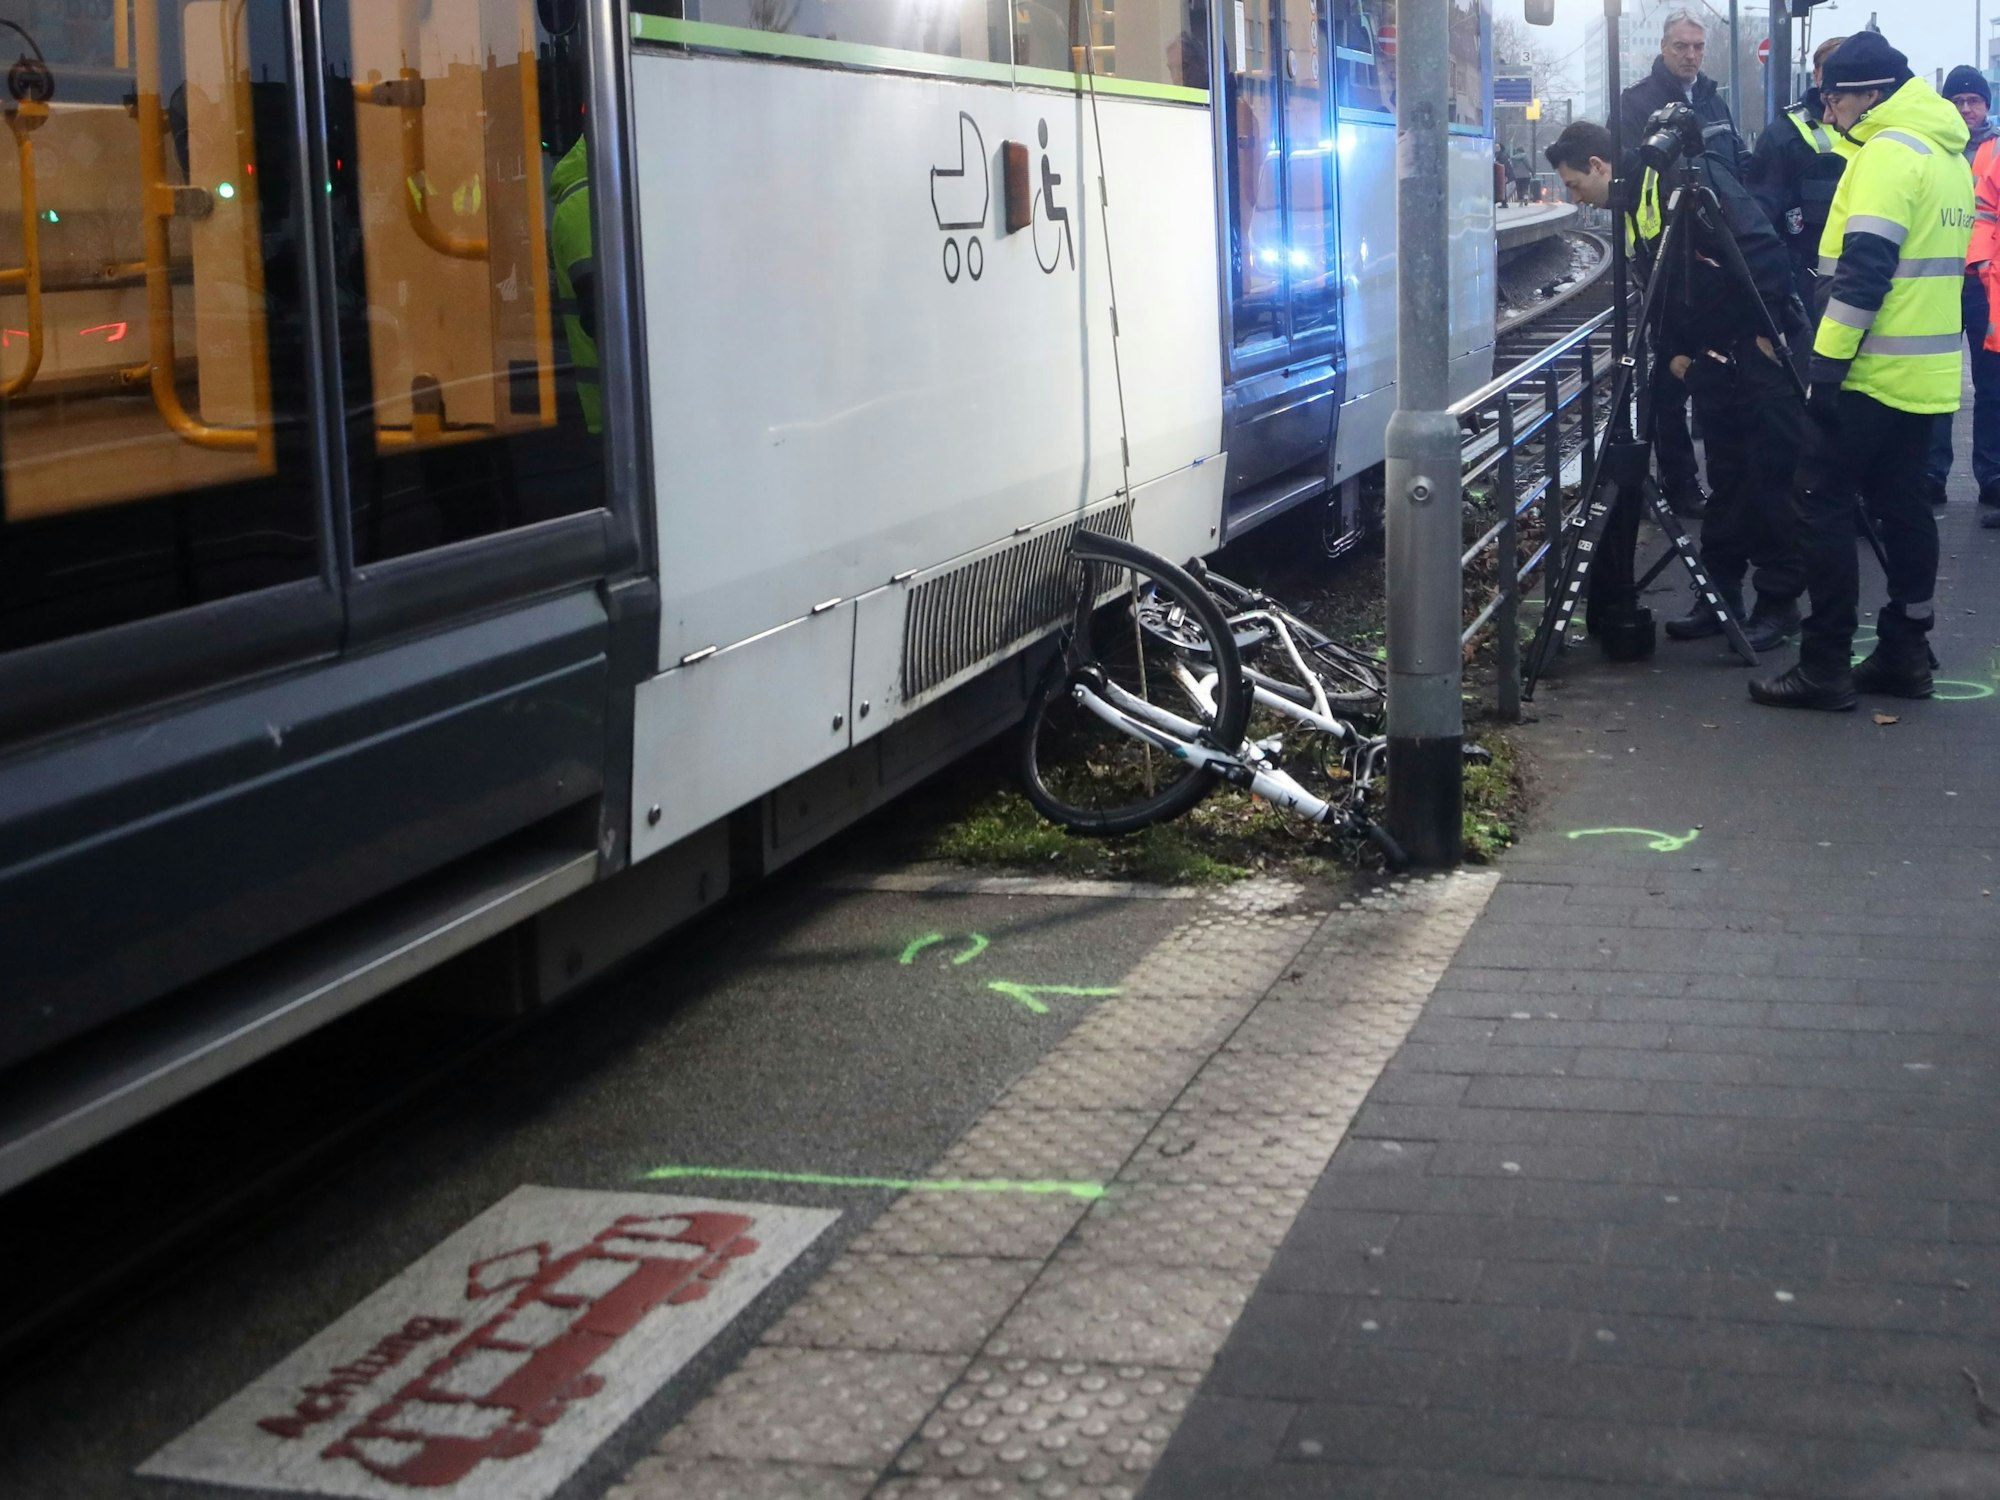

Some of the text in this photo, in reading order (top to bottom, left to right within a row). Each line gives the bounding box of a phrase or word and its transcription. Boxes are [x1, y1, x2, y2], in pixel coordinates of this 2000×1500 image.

[1522, 51, 1530, 62] 3
[1941, 208, 1955, 227] VU
[256, 1315, 463, 1440] Achtung
